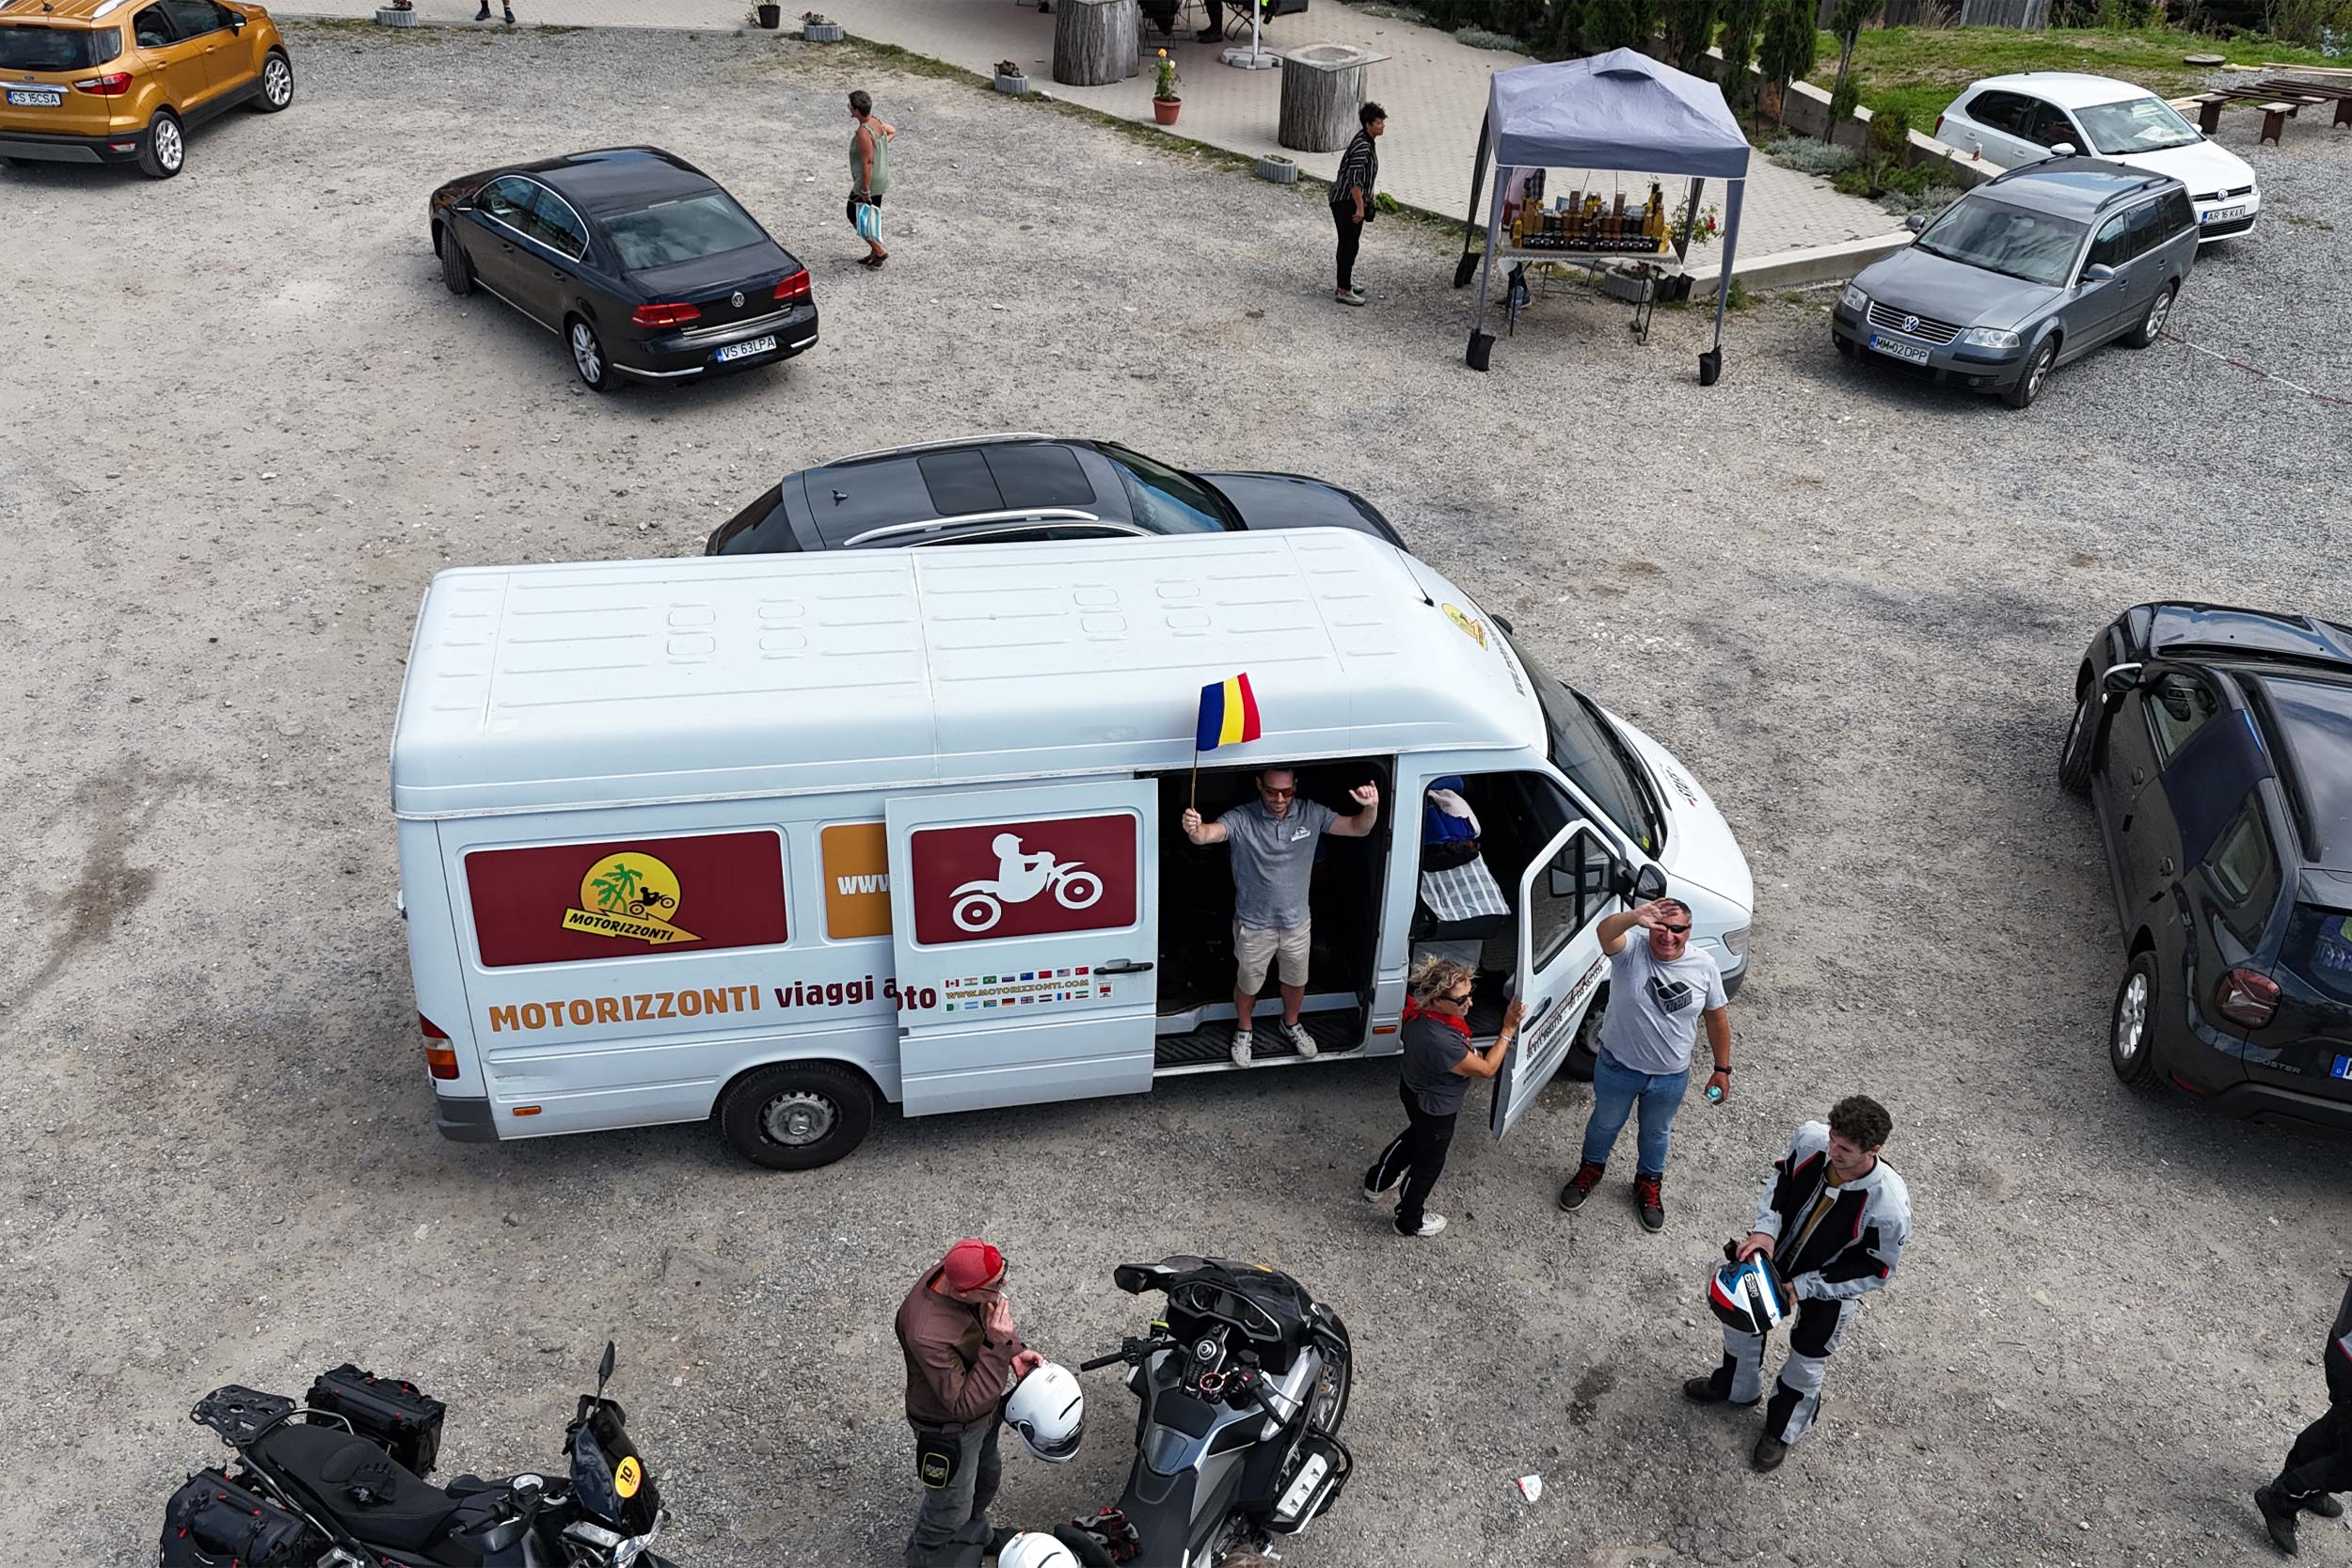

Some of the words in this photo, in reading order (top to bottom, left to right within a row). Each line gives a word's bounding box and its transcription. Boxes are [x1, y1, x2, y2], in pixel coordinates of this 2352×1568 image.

[12, 93, 25, 103] CS
[2208, 211, 2219, 221] AR
[723, 345, 739, 358] VS
[741, 337, 775, 356] 63LPA
[1875, 338, 1890, 351] MM
[568, 912, 675, 942] MOTORIZZONTI
[488, 984, 761, 1033] MOTORIZZONTI
[773, 974, 875, 1008] viaggi
[619, 1465, 634, 1483] 10
